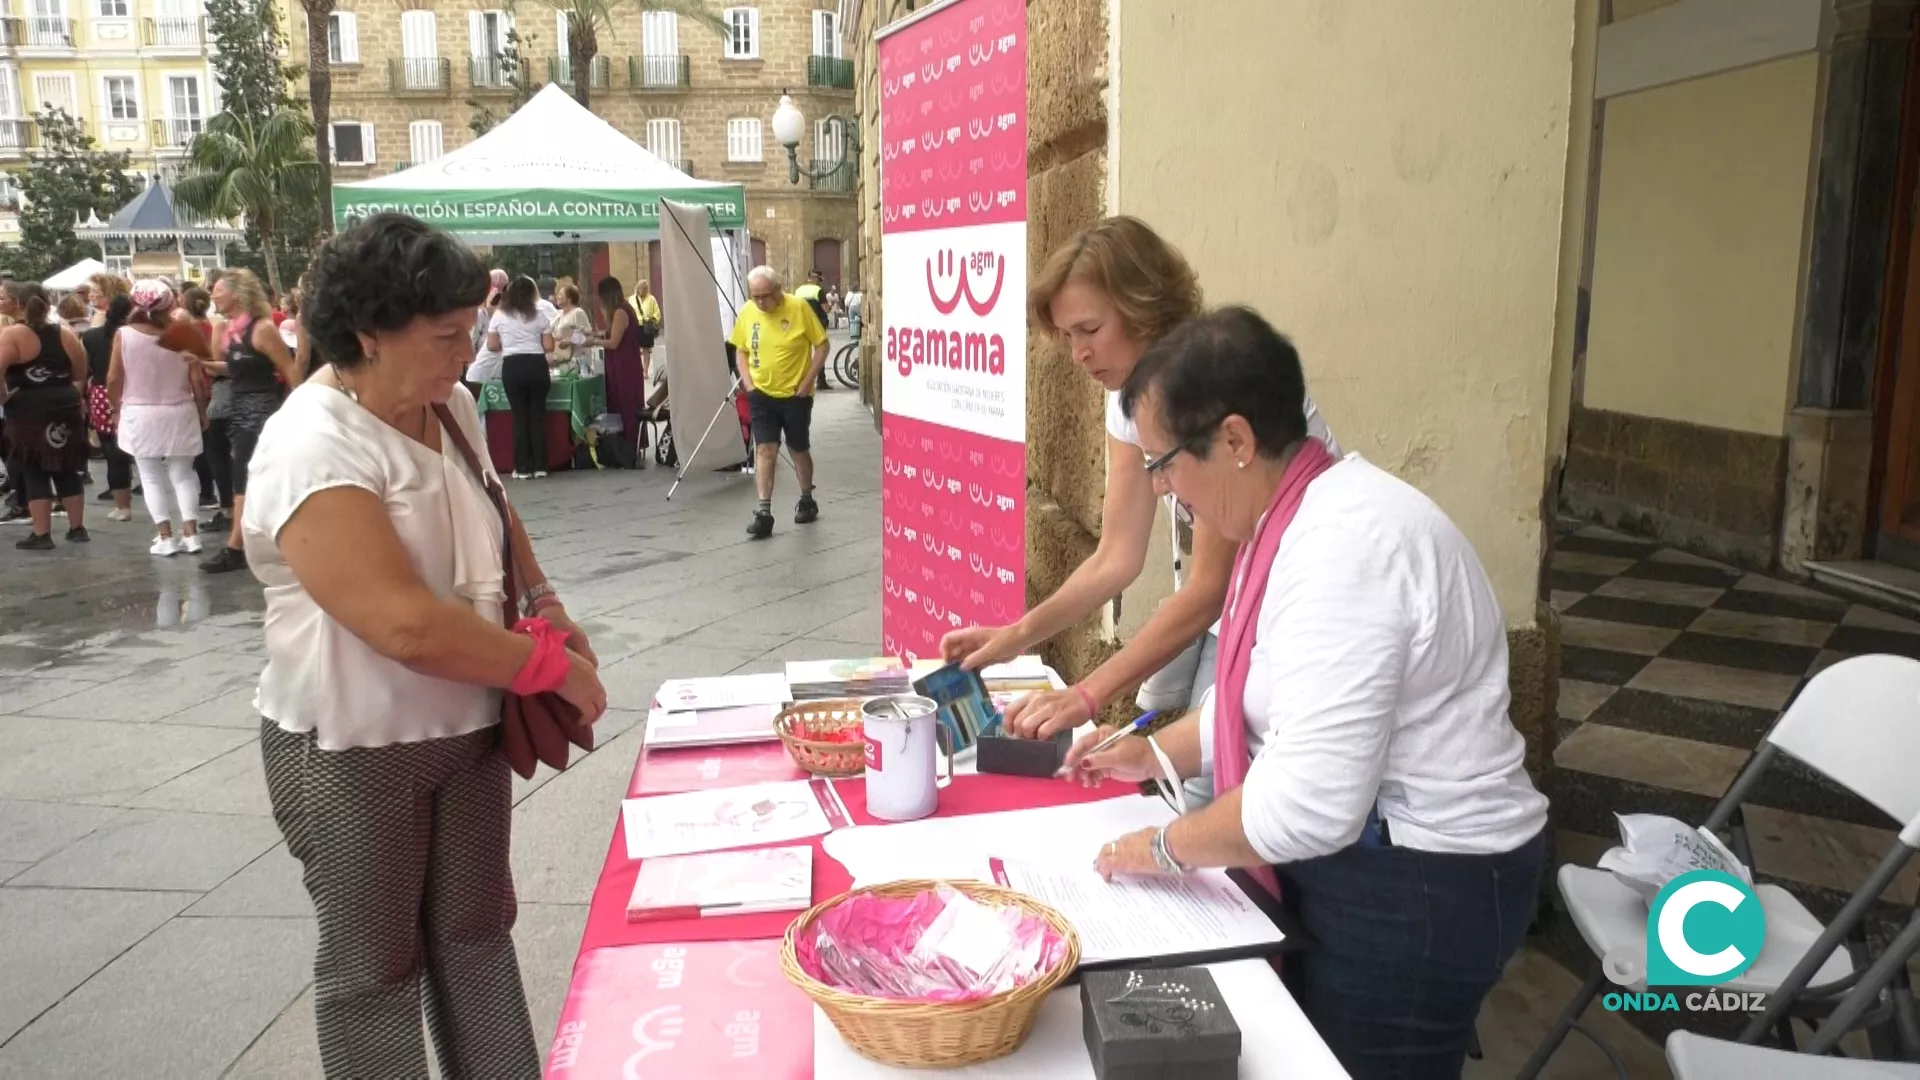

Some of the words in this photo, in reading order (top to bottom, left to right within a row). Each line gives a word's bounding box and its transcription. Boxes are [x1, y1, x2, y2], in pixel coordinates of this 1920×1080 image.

[947, 55, 961, 72] agm
[997, 33, 1016, 54] agm
[946, 127, 961, 144] agm
[997, 113, 1016, 131] agm
[463, 198, 560, 218] ESPAÑOLA
[568, 201, 637, 217] CONTRA
[642, 202, 660, 217] EL
[946, 197, 961, 214] agm
[997, 189, 1016, 208] agm
[970, 251, 994, 276] agm
[887, 325, 1005, 378] agamama
[947, 478, 962, 494] agm
[996, 494, 1015, 512] agm
[947, 545, 962, 562] agm
[996, 567, 1015, 584] agm
[948, 611, 962, 627] agm
[652, 947, 687, 990] agm
